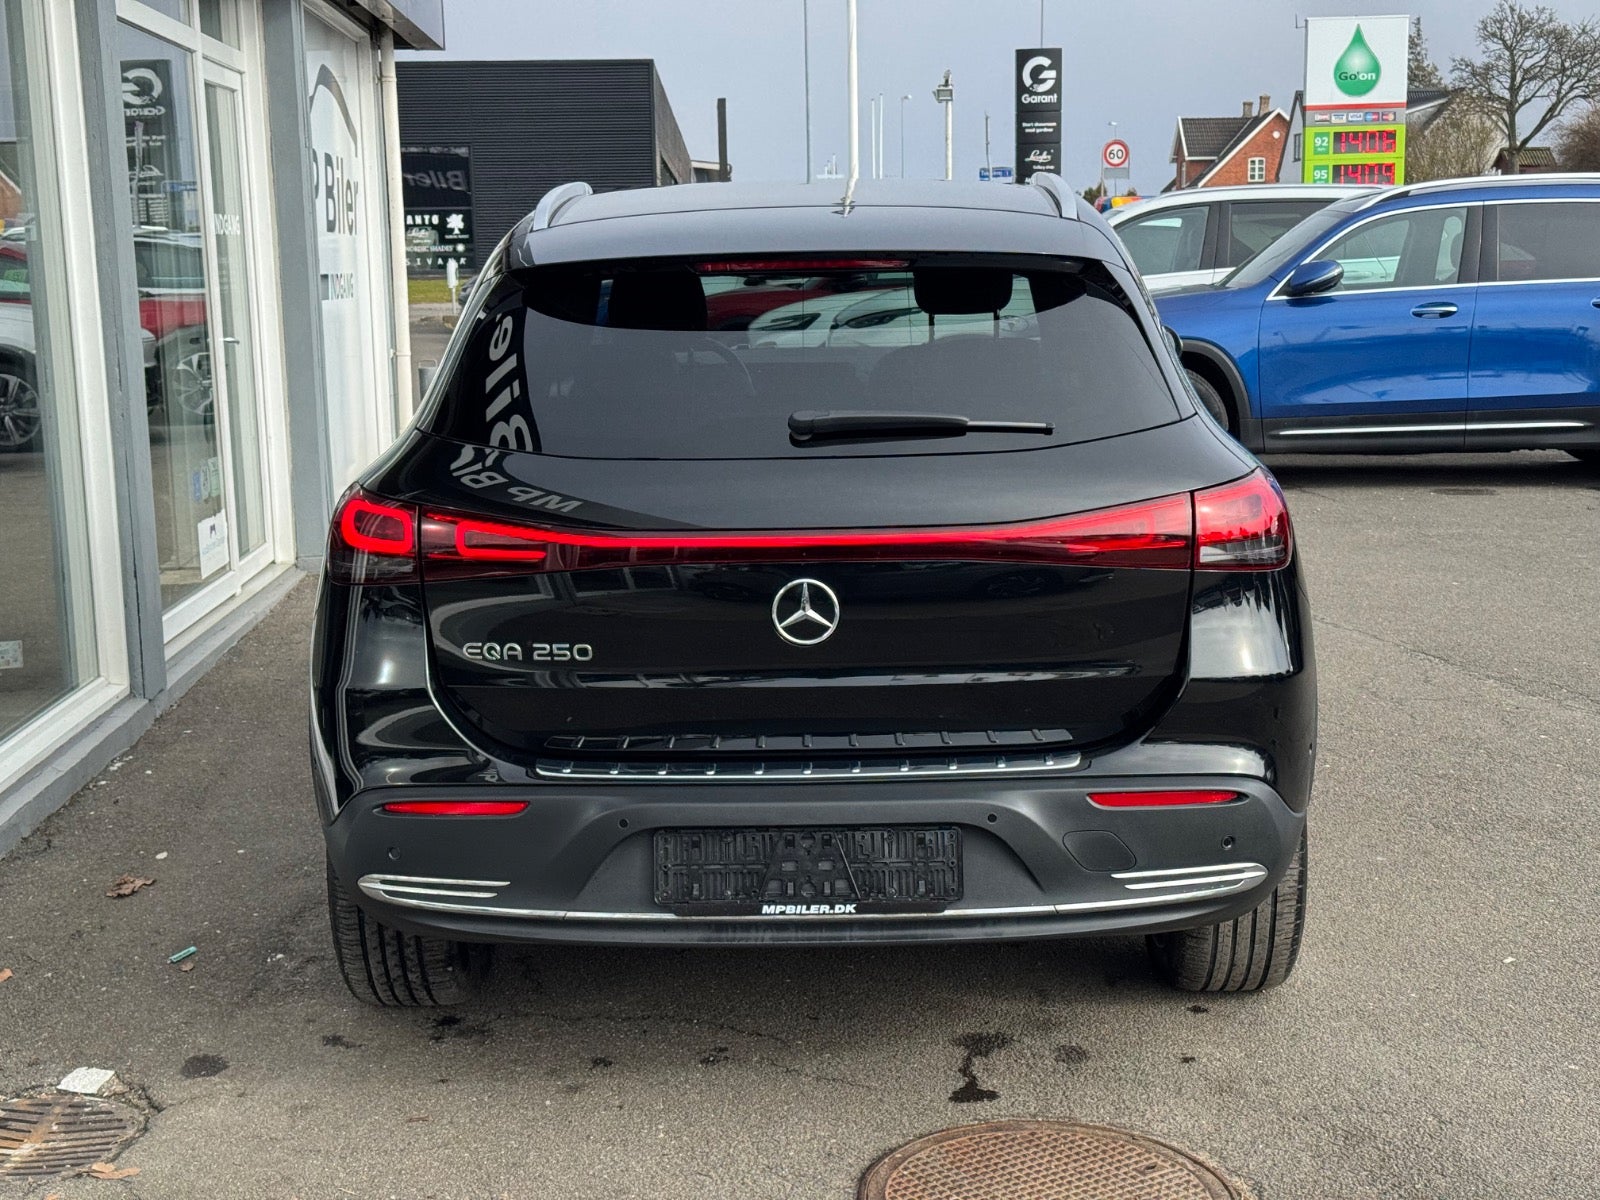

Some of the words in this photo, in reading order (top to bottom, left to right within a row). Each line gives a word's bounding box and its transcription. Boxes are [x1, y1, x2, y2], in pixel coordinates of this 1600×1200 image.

[1021, 93, 1058, 103] Garant
[1314, 137, 1329, 147] 92
[1108, 149, 1124, 160] 60
[1313, 170, 1328, 180] 95
[324, 152, 358, 236] Biler
[462, 642, 523, 661] EQA
[532, 643, 593, 661] 250
[761, 903, 857, 915] MPBILER.DK
